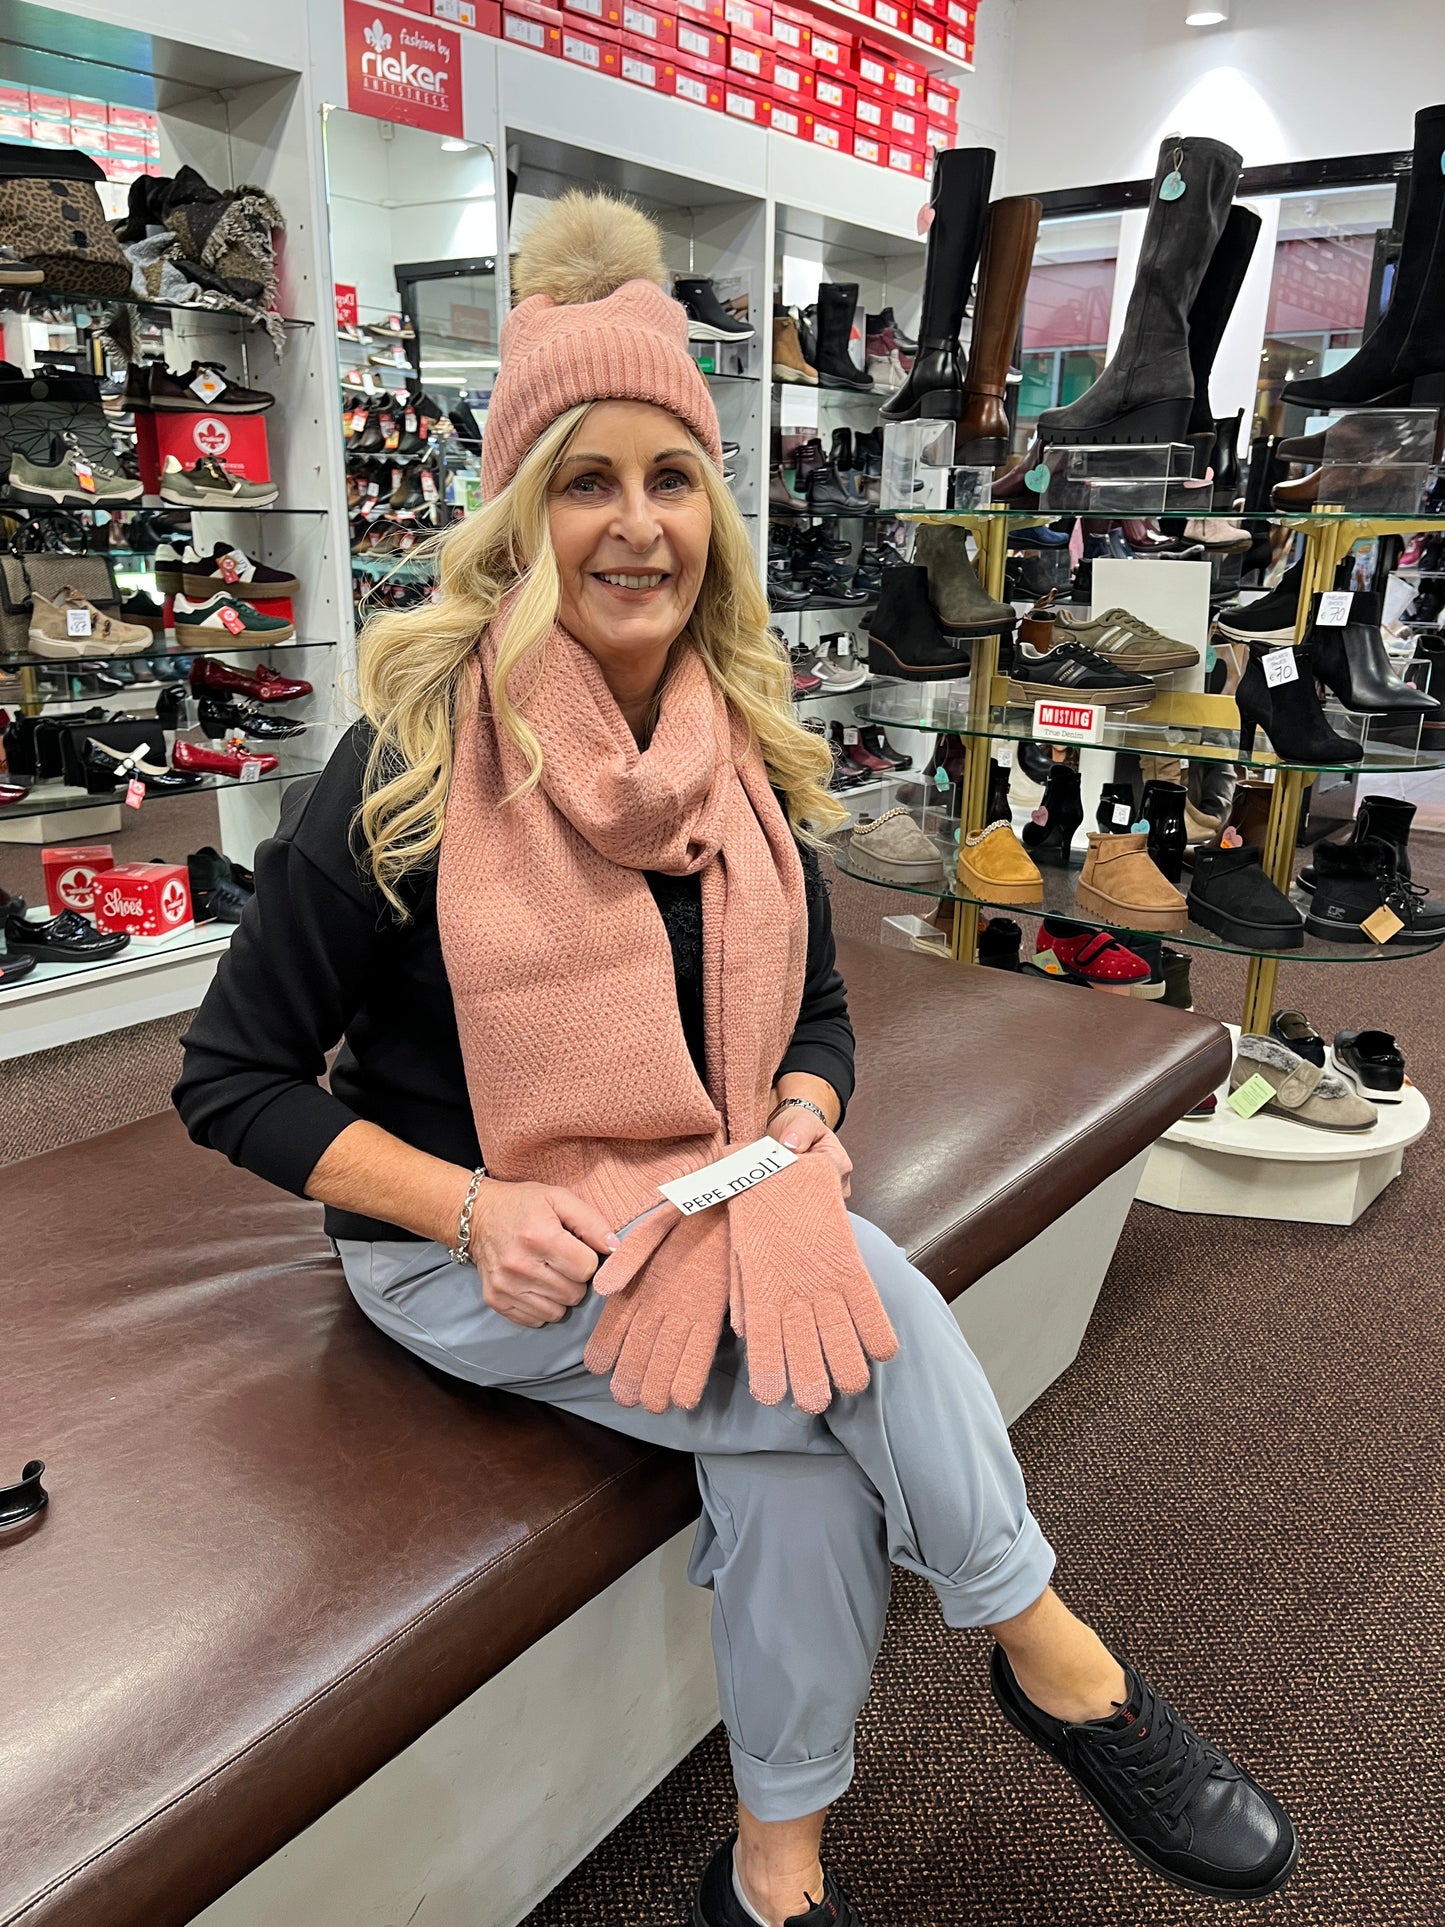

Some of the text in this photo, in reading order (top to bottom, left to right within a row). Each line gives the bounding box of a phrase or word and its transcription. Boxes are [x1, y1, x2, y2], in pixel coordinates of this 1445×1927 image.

[400, 28, 451, 64] fashion by
[361, 51, 448, 93] rieker
[363, 77, 446, 109] ANTISTRESS
[1041, 707, 1090, 727] MUSTANG
[1061, 730, 1084, 739] Denim
[102, 887, 144, 917] Shoes
[682, 1157, 782, 1212] PEPE moll
